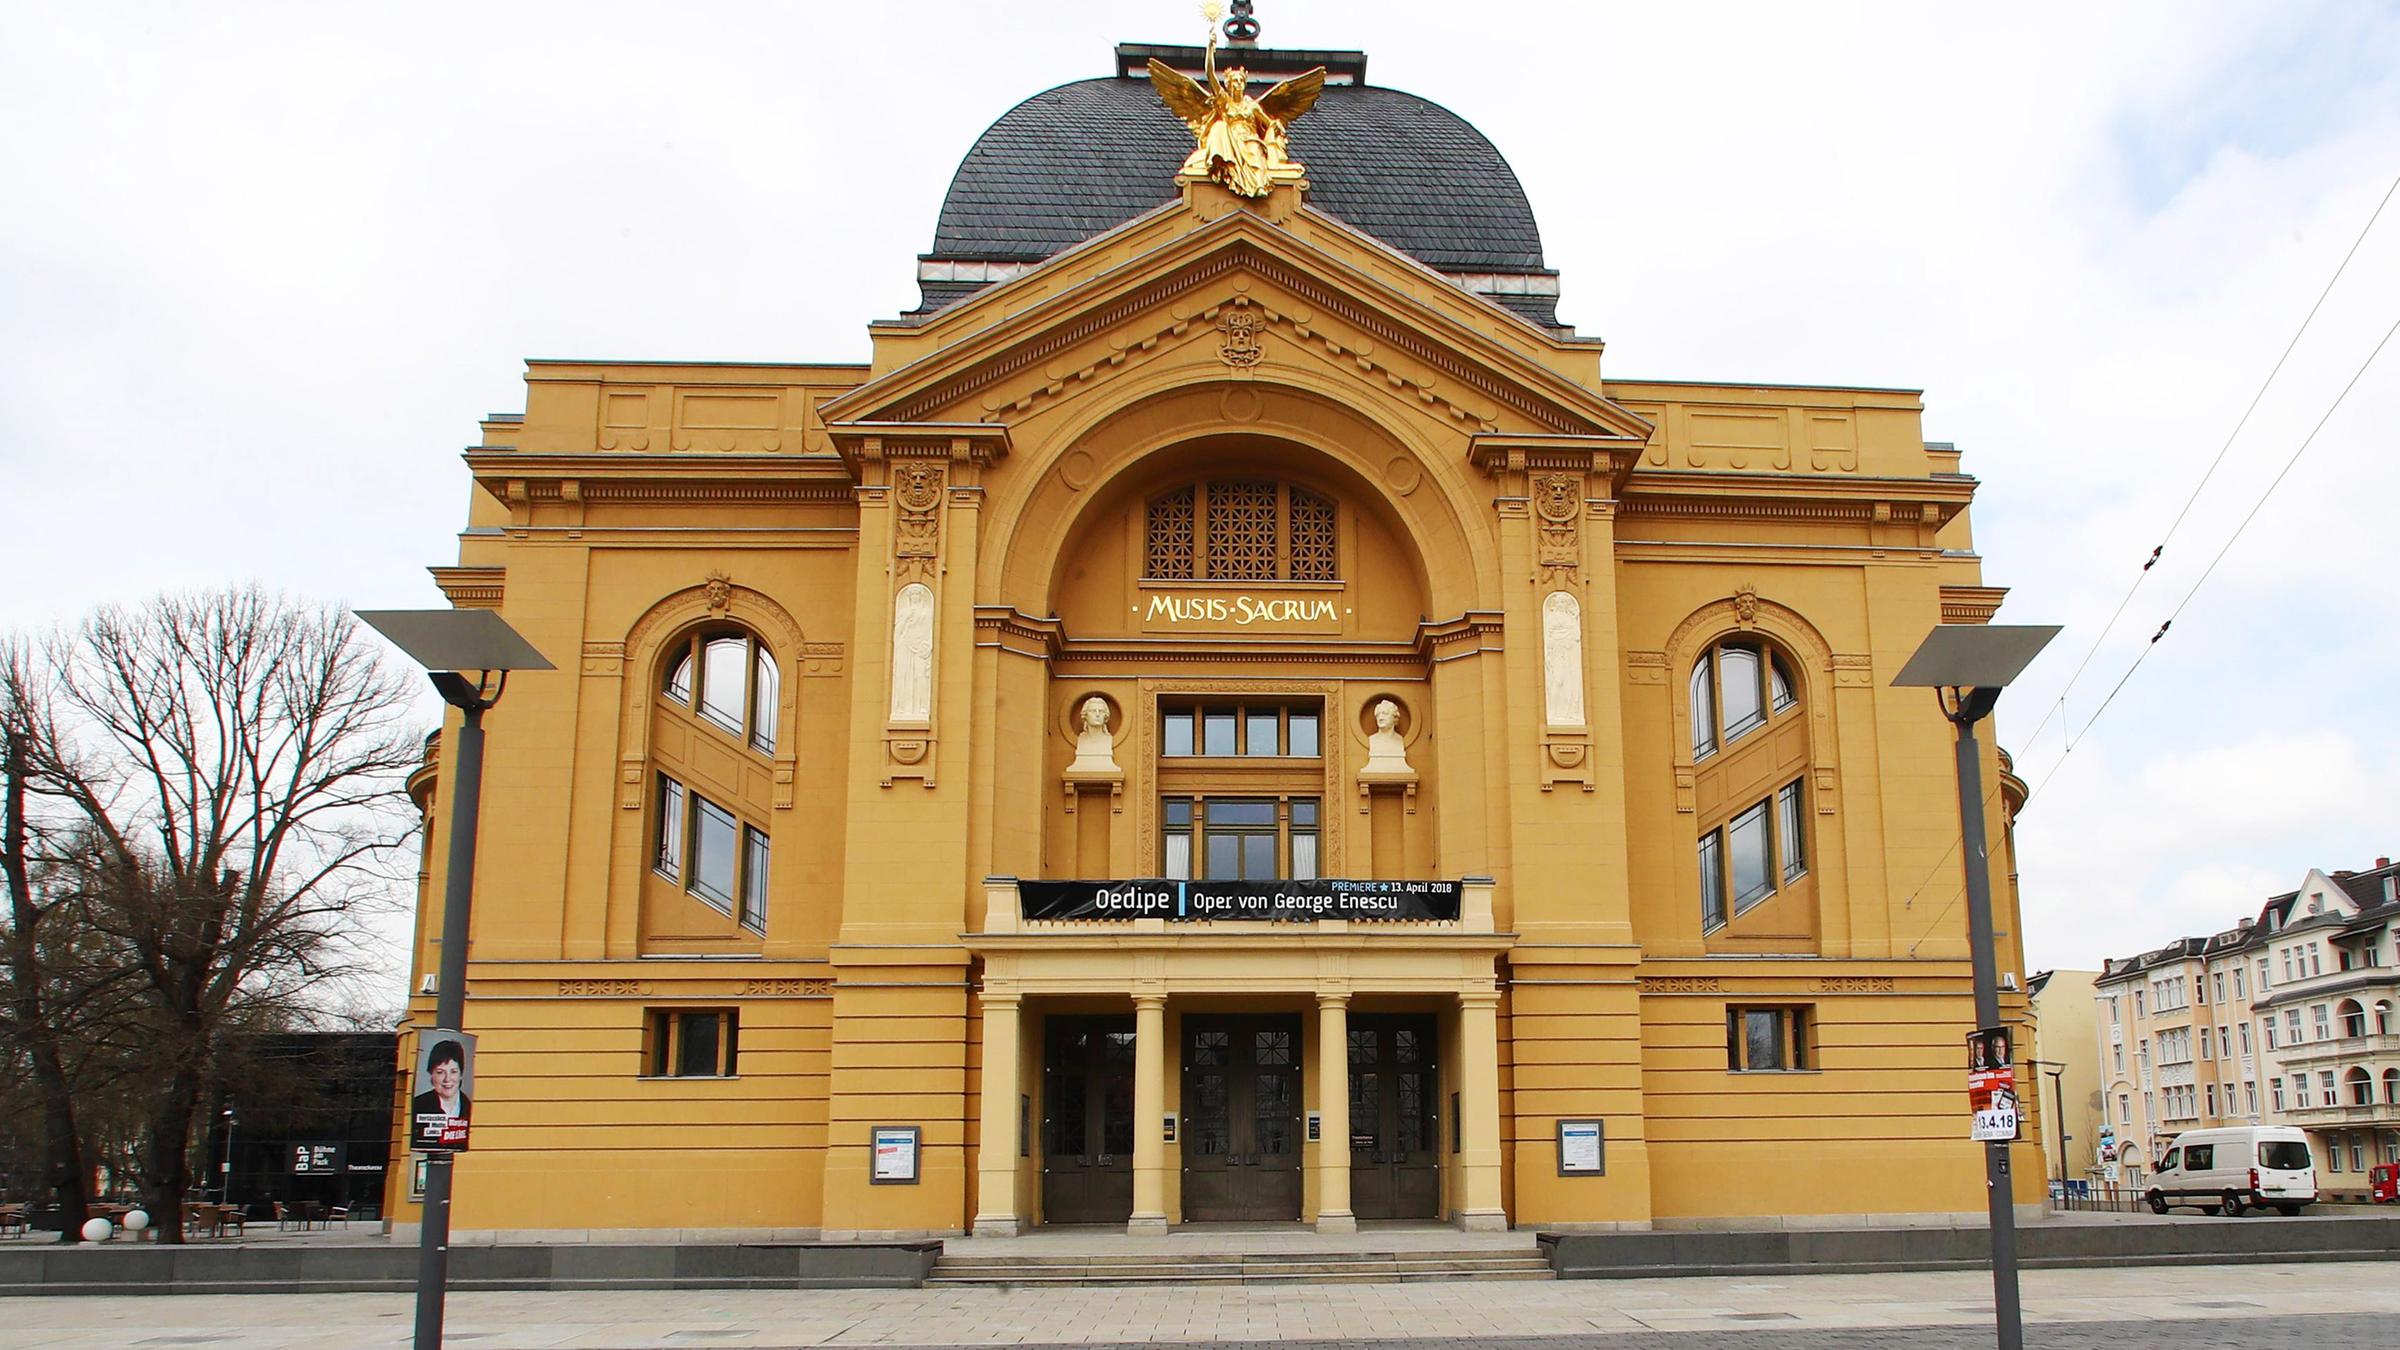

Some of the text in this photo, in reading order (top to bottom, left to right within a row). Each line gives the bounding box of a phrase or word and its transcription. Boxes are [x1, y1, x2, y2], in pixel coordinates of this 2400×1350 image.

[1331, 882, 1452, 895] PREMIERE 13. April 2018
[1095, 887, 1170, 915] Oedipe
[1193, 893, 1398, 913] Oper von George Enescu
[295, 1146, 310, 1171] BaP
